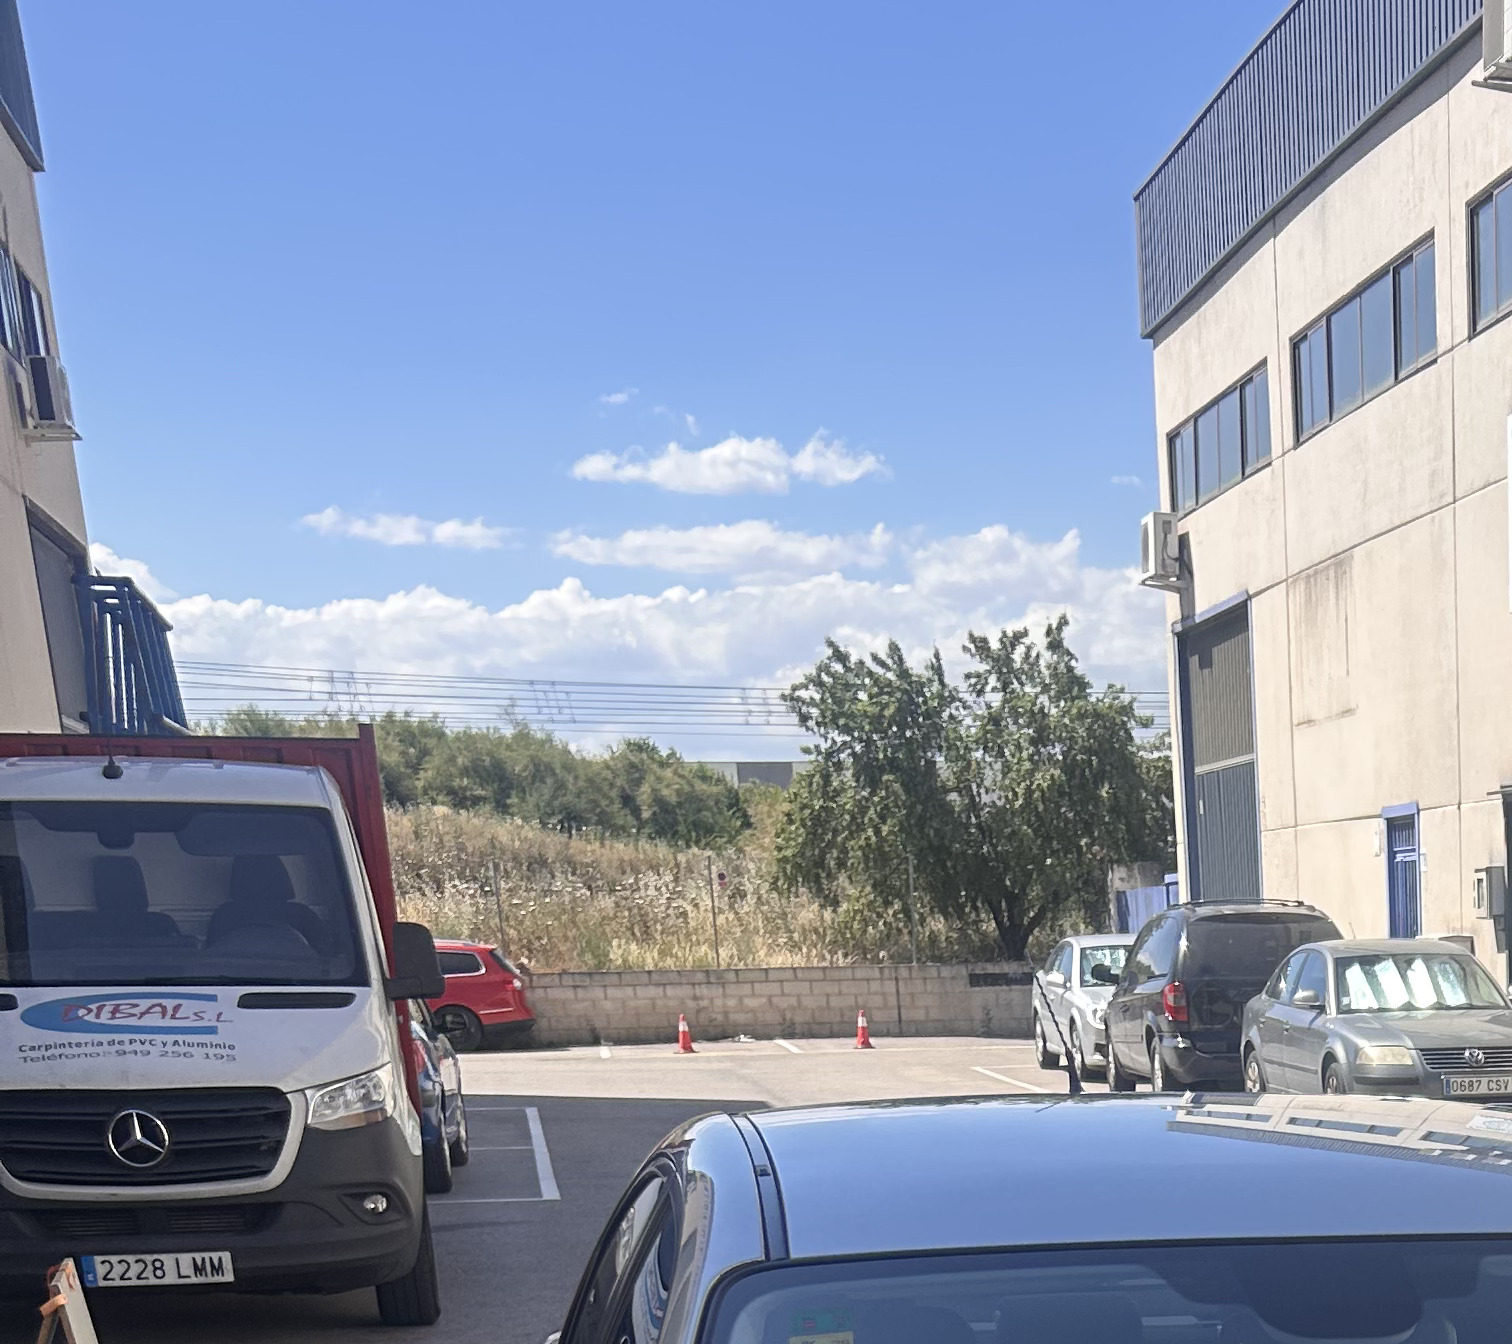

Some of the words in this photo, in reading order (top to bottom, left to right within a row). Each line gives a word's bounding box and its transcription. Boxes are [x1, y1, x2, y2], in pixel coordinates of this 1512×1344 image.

[61, 1003, 190, 1022] DIBAL
[107, 1038, 125, 1047] de
[128, 1038, 157, 1047] PVC
[161, 1040, 168, 1048] y
[172, 1039, 236, 1051] Aluminio
[114, 1048, 151, 1057] 949
[159, 1049, 194, 1059] 256
[1451, 1079, 1482, 1093] 0687
[100, 1257, 167, 1282] 2228
[175, 1255, 226, 1280] LMM
